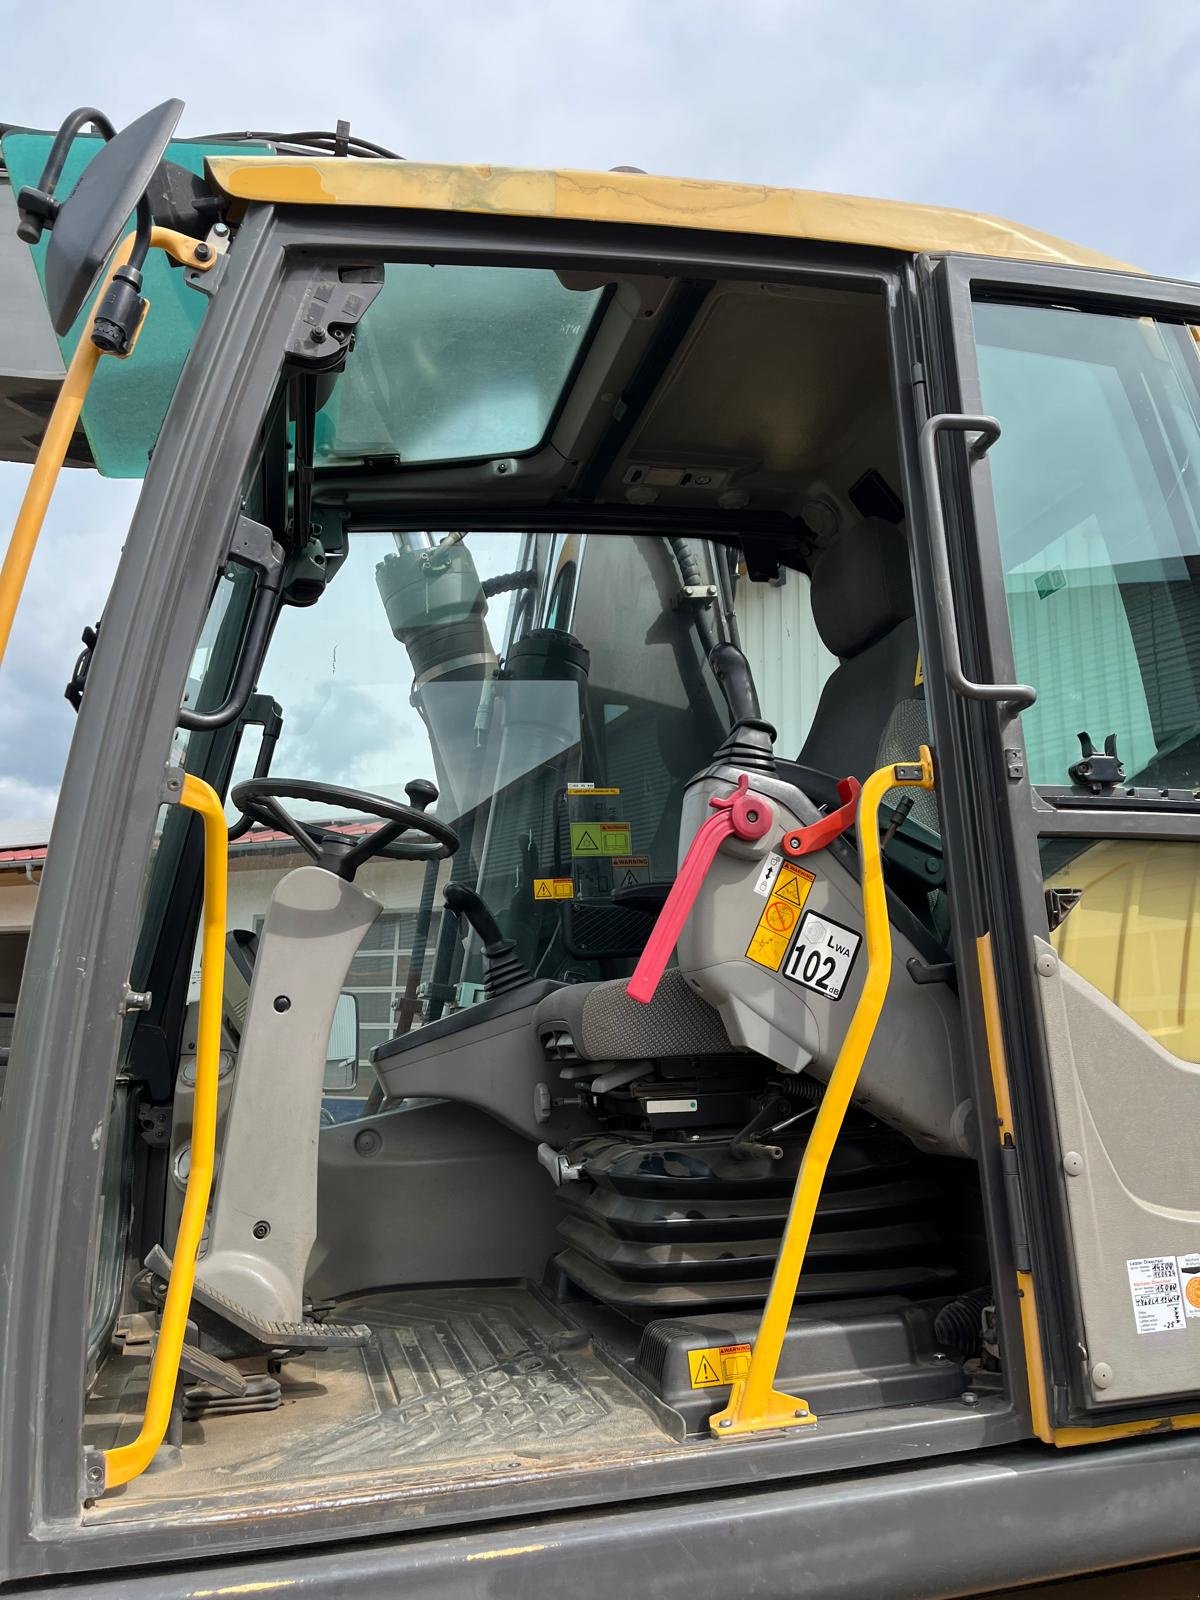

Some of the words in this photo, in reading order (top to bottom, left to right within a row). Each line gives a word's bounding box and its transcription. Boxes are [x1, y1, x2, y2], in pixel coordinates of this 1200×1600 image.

[618, 858, 648, 866] WARNING
[789, 865, 814, 881] WARNING
[790, 944, 836, 990] 102
[828, 986, 840, 996] dB
